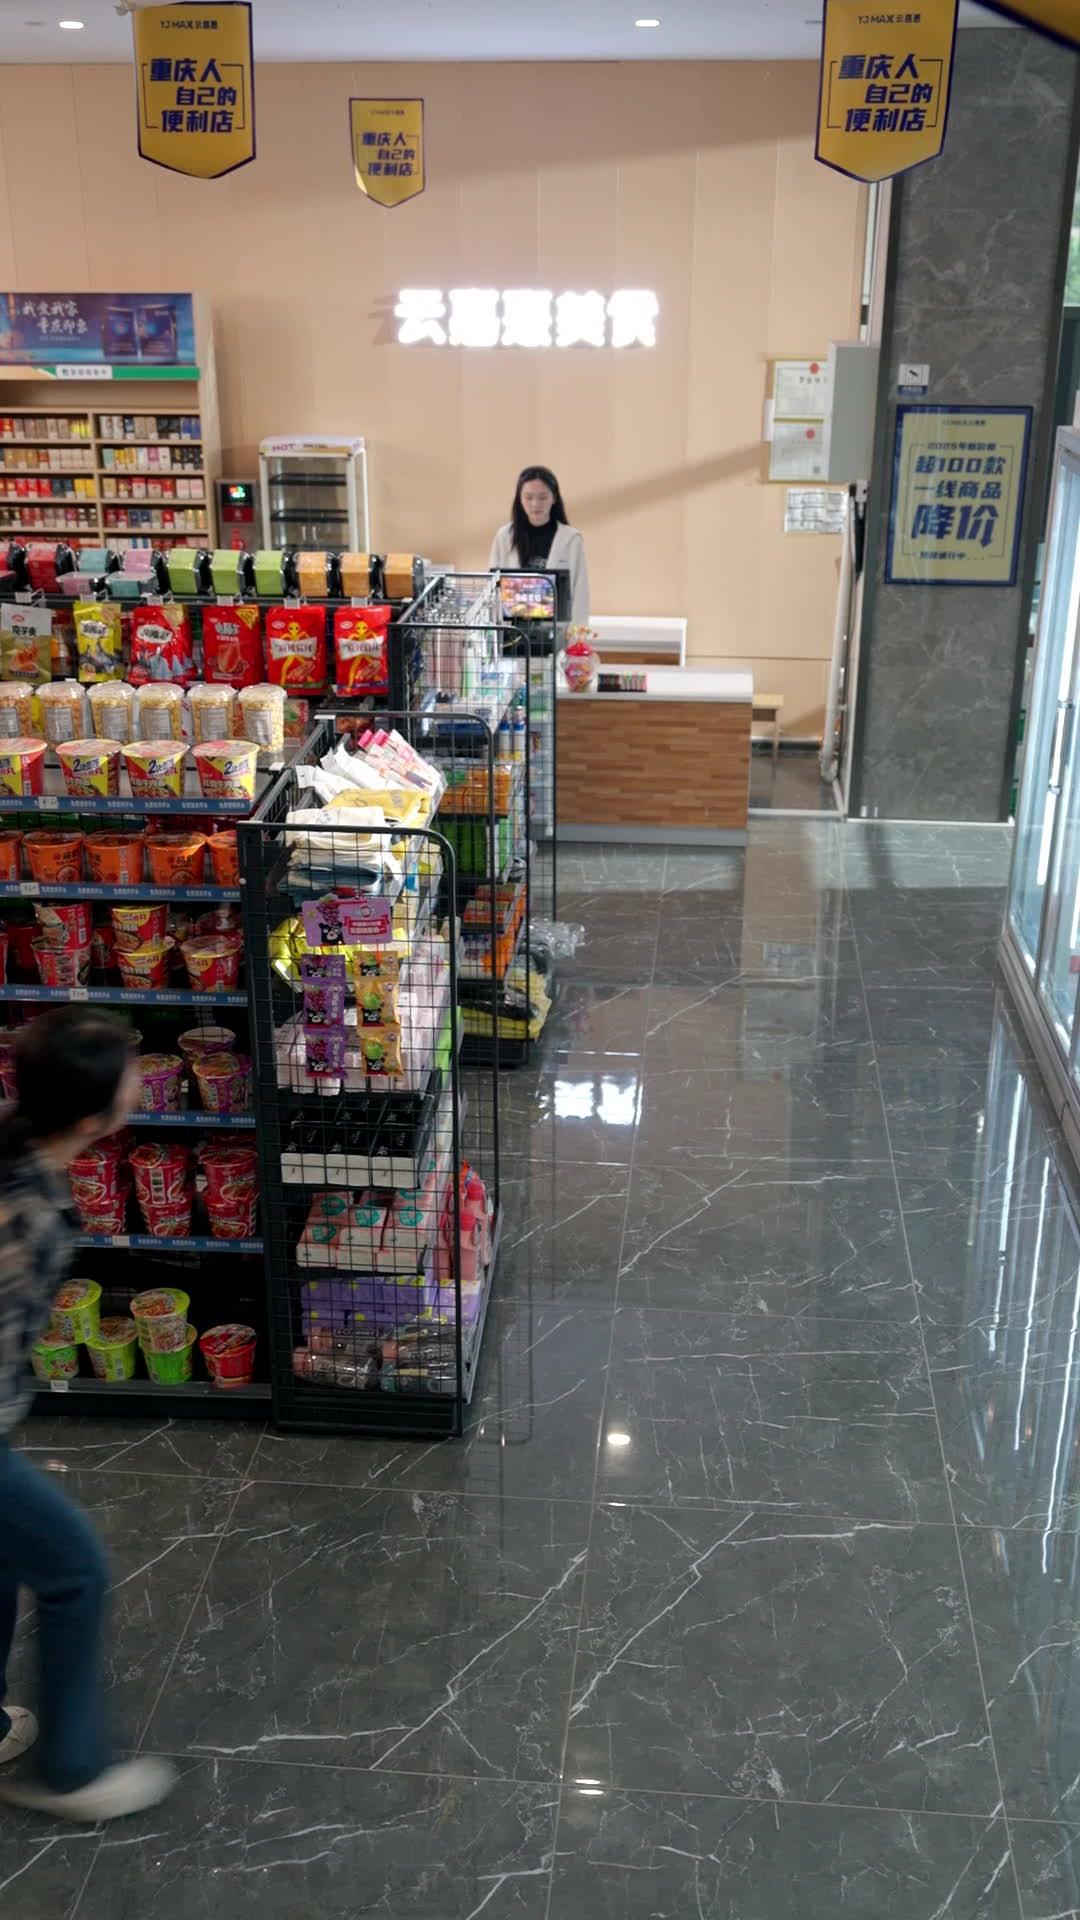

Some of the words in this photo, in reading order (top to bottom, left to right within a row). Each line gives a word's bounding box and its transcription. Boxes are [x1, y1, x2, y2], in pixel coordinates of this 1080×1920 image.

[150, 58, 222, 82] 重庆人
[838, 54, 919, 79] 重庆人
[176, 86, 237, 106] 自己的
[865, 83, 933, 104] 自己的
[161, 110, 234, 133] 便利店
[845, 108, 927, 132] 便利店
[362, 132, 406, 146] 重庆人
[378, 149, 415, 160] 自己的
[368, 163, 413, 176] 便利店
[22, 301, 79, 317] 我爱我家
[915, 456, 1006, 475] 超100款
[914, 480, 1002, 499] 一线商品
[911, 503, 998, 548] 降价
